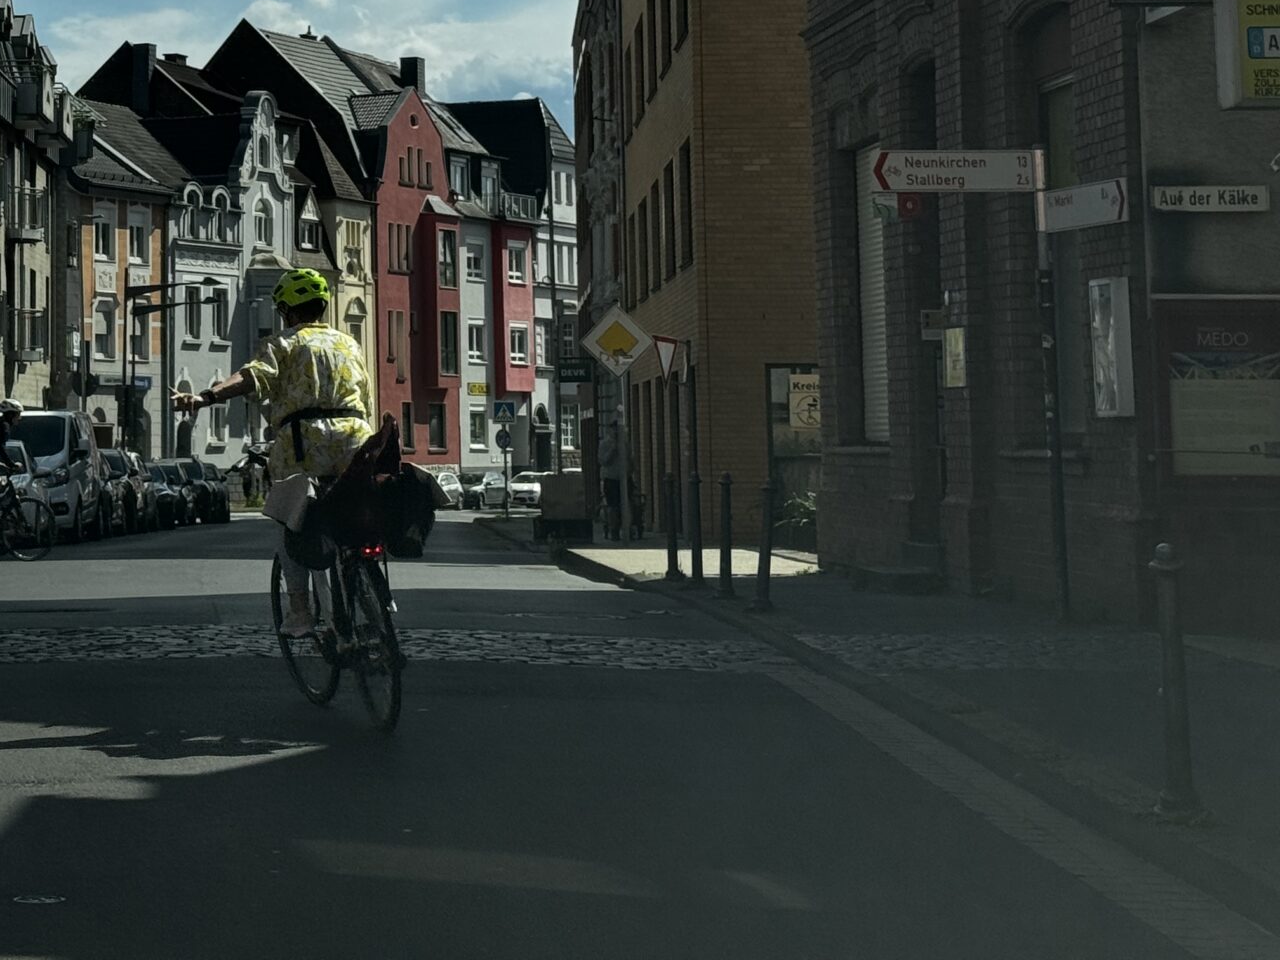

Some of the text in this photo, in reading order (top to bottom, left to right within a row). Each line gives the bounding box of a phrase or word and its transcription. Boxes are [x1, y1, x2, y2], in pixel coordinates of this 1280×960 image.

[1245, 3, 1280, 16] SCHN
[904, 155, 1028, 169] Neunkirchen 13
[906, 173, 966, 188] Stallberg
[1159, 188, 1259, 207] Auf der Kälke
[1197, 331, 1249, 346] MEDO
[561, 368, 586, 377] DEVK
